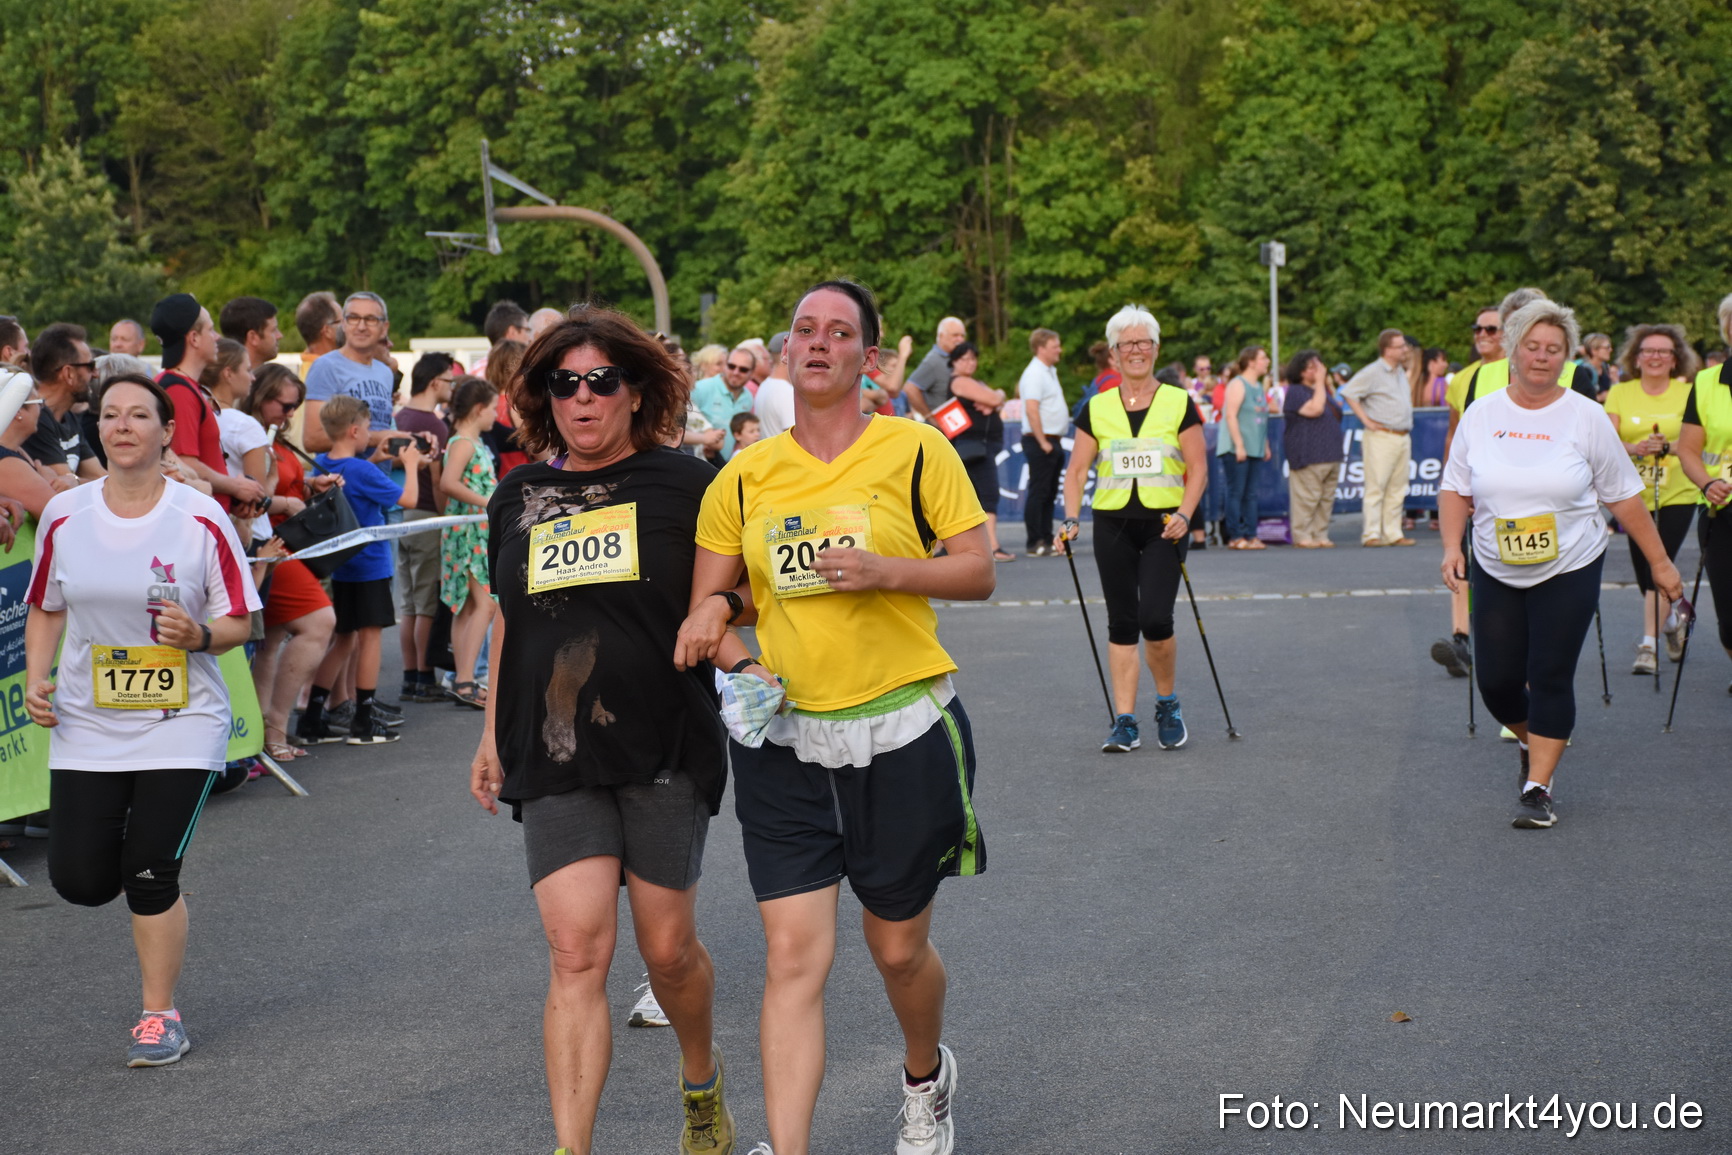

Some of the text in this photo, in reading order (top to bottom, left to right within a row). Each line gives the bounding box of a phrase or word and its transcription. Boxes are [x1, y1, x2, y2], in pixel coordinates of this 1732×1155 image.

[1122, 455, 1152, 468] 9103
[778, 525, 818, 539] firmenlauf
[1504, 532, 1550, 551] 1145
[541, 532, 622, 571] 2008
[578, 562, 608, 571] Andrea
[535, 570, 602, 586] Regens-Wagner-Stiftung
[789, 571, 824, 582] Micklisc
[104, 668, 174, 691] 1779
